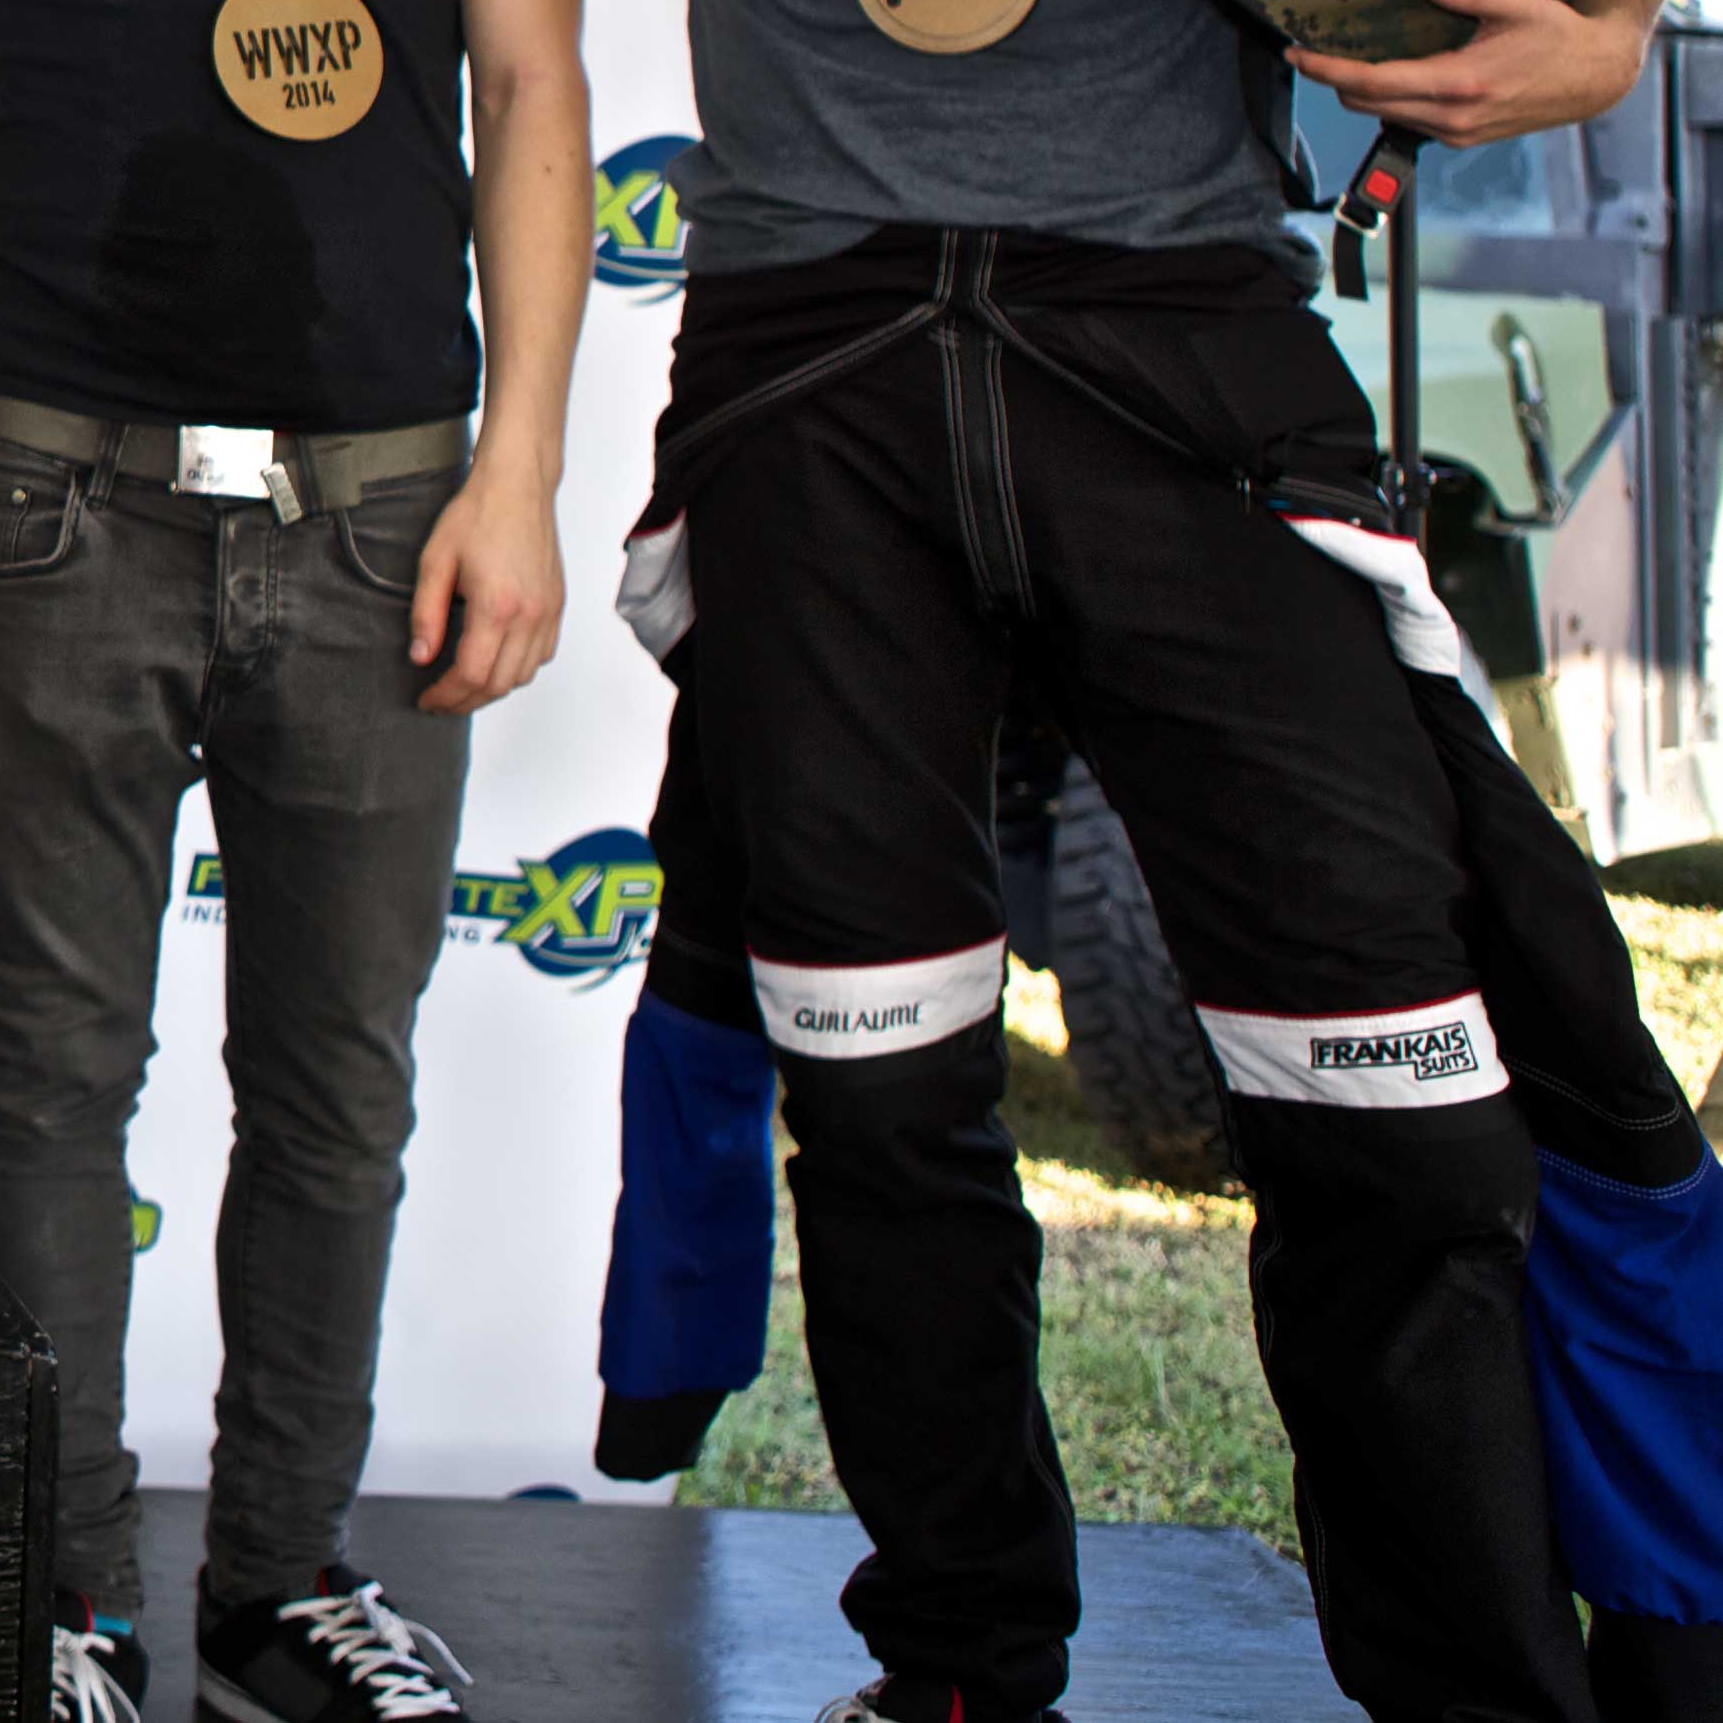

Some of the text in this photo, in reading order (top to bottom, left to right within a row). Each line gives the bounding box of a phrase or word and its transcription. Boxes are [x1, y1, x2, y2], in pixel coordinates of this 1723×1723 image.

[233, 20, 362, 80] WWXP
[282, 80, 336, 109] 2014
[499, 860, 664, 942] XP
[1317, 1027, 1467, 1064] FRANKAIS
[1420, 1051, 1471, 1075] SUITS
